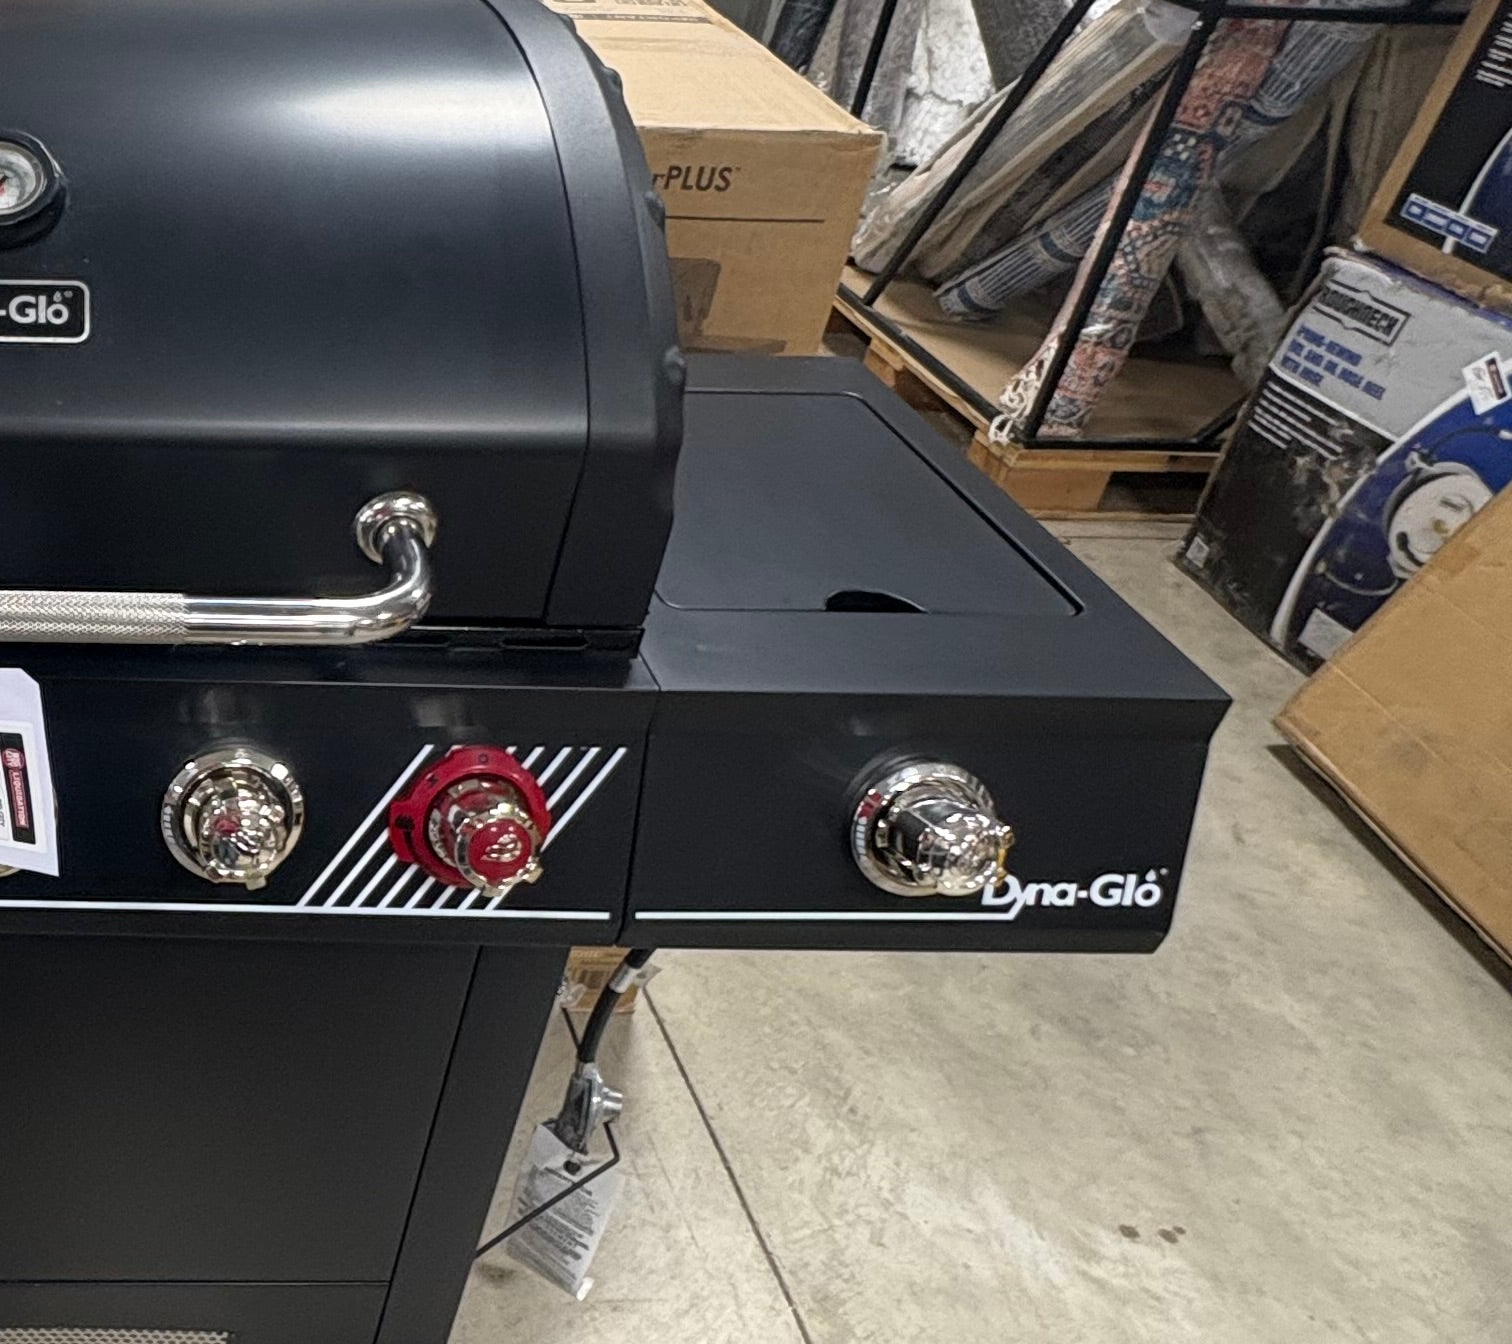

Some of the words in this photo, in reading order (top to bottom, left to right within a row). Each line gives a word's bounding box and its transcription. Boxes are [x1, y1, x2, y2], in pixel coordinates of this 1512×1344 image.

[652, 165, 733, 192] rPLUS
[11, 771, 27, 827] LIQUIDATION
[981, 869, 1163, 918] Dyna-Glo
